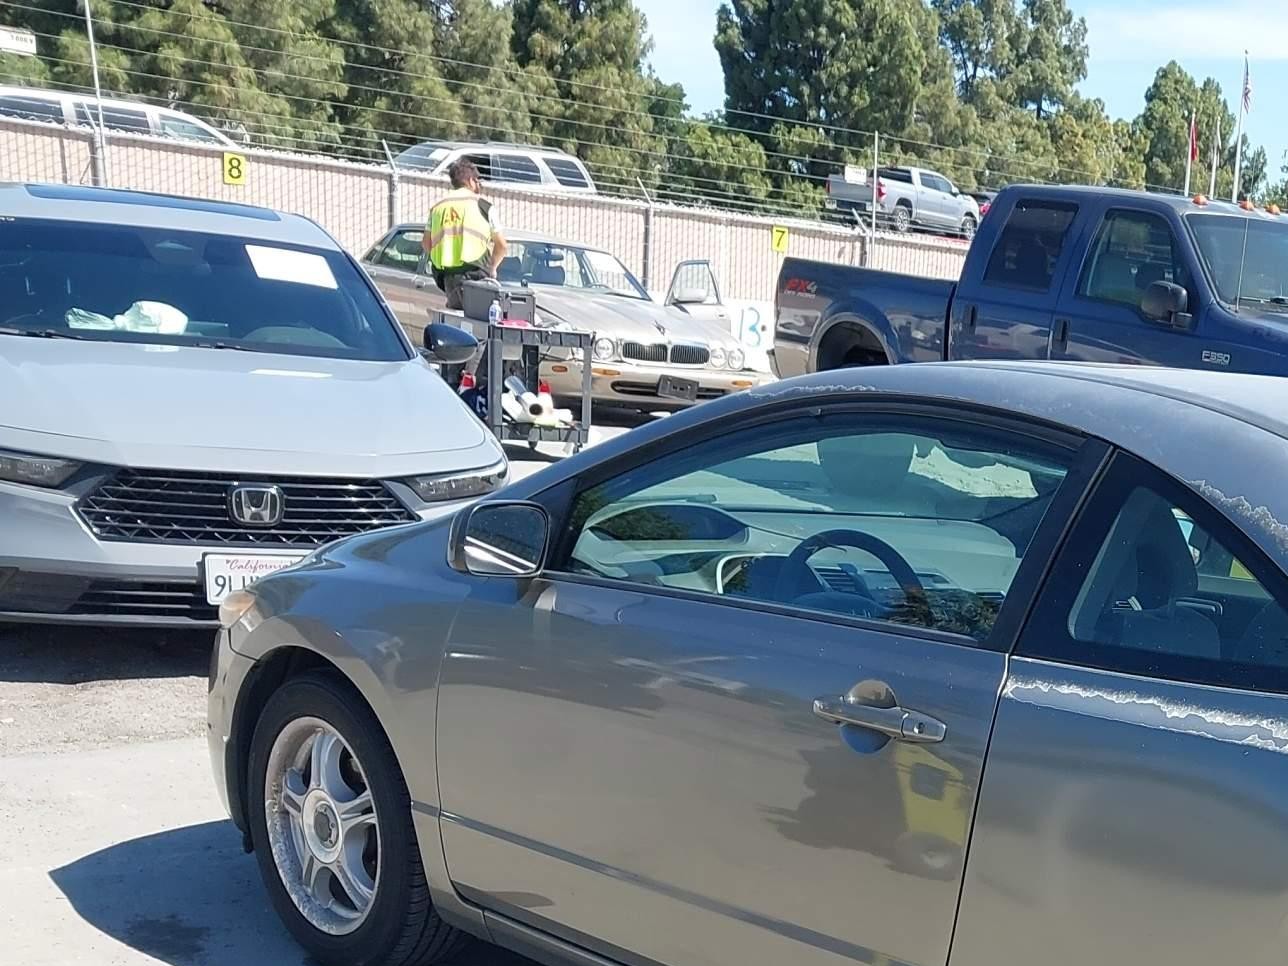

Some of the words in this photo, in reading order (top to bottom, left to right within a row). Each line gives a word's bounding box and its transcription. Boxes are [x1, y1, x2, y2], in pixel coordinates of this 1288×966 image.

[228, 157, 242, 179] 8
[775, 229, 787, 248] 7
[229, 559, 289, 574] California
